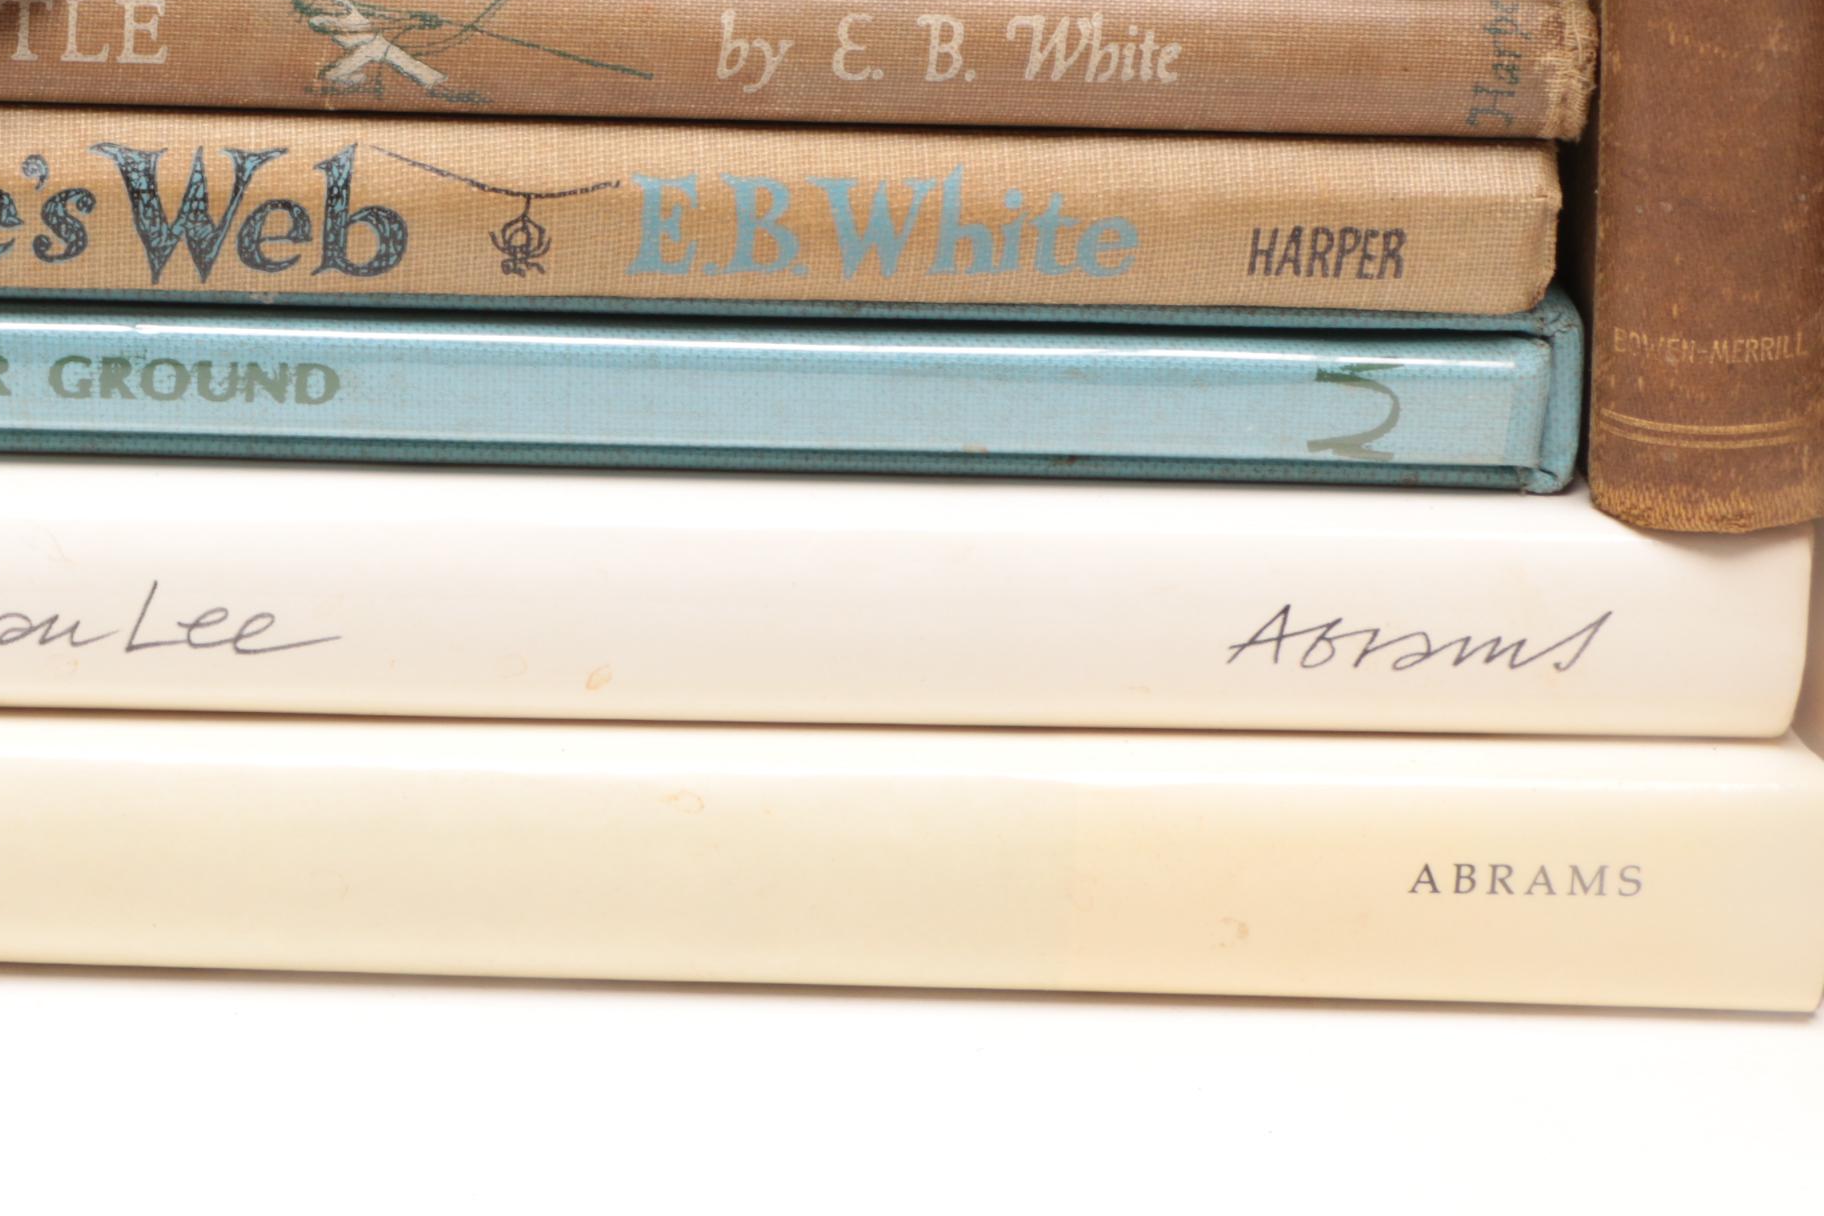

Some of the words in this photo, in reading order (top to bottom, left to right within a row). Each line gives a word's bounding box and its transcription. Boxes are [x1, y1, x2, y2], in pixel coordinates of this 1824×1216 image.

[715, 9, 790, 94] by
[831, 13, 885, 83] E.
[925, 20, 976, 84] B.
[1005, 12, 1182, 85] White
[88, 139, 410, 286] Web
[1246, 224, 1408, 281] HARPER
[47, 353, 341, 406] GROUND
[122, 578, 343, 656] Lee
[1226, 603, 1615, 673] Abrams
[1406, 861, 1645, 900] ABRAMS
